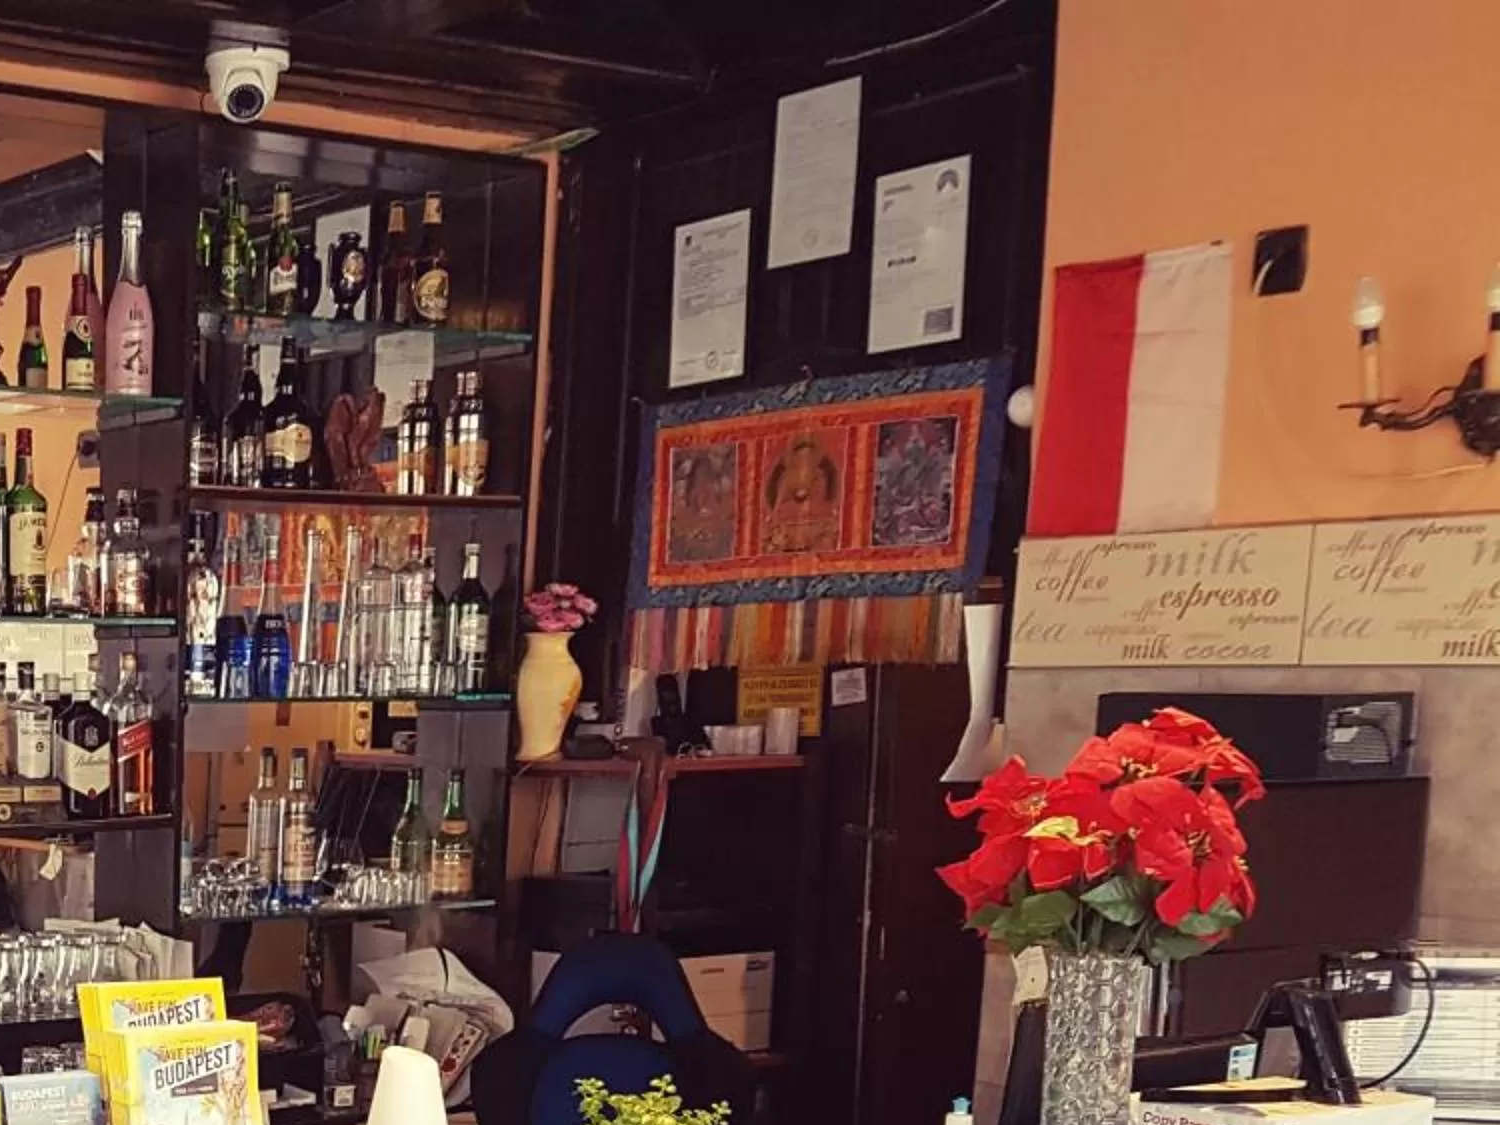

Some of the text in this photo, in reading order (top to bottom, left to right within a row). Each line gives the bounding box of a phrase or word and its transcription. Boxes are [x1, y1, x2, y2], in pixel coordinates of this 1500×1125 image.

[1034, 545, 1110, 603] coffee
[1144, 531, 1258, 578] milk
[1332, 530, 1427, 593] coffee
[1159, 581, 1282, 621] espresso
[1306, 601, 1375, 639] tea
[1013, 609, 1069, 643] tea
[1120, 633, 1172, 660] milk
[1183, 643, 1272, 660] cocoa
[155, 1043, 233, 1090] BUDAPEST
